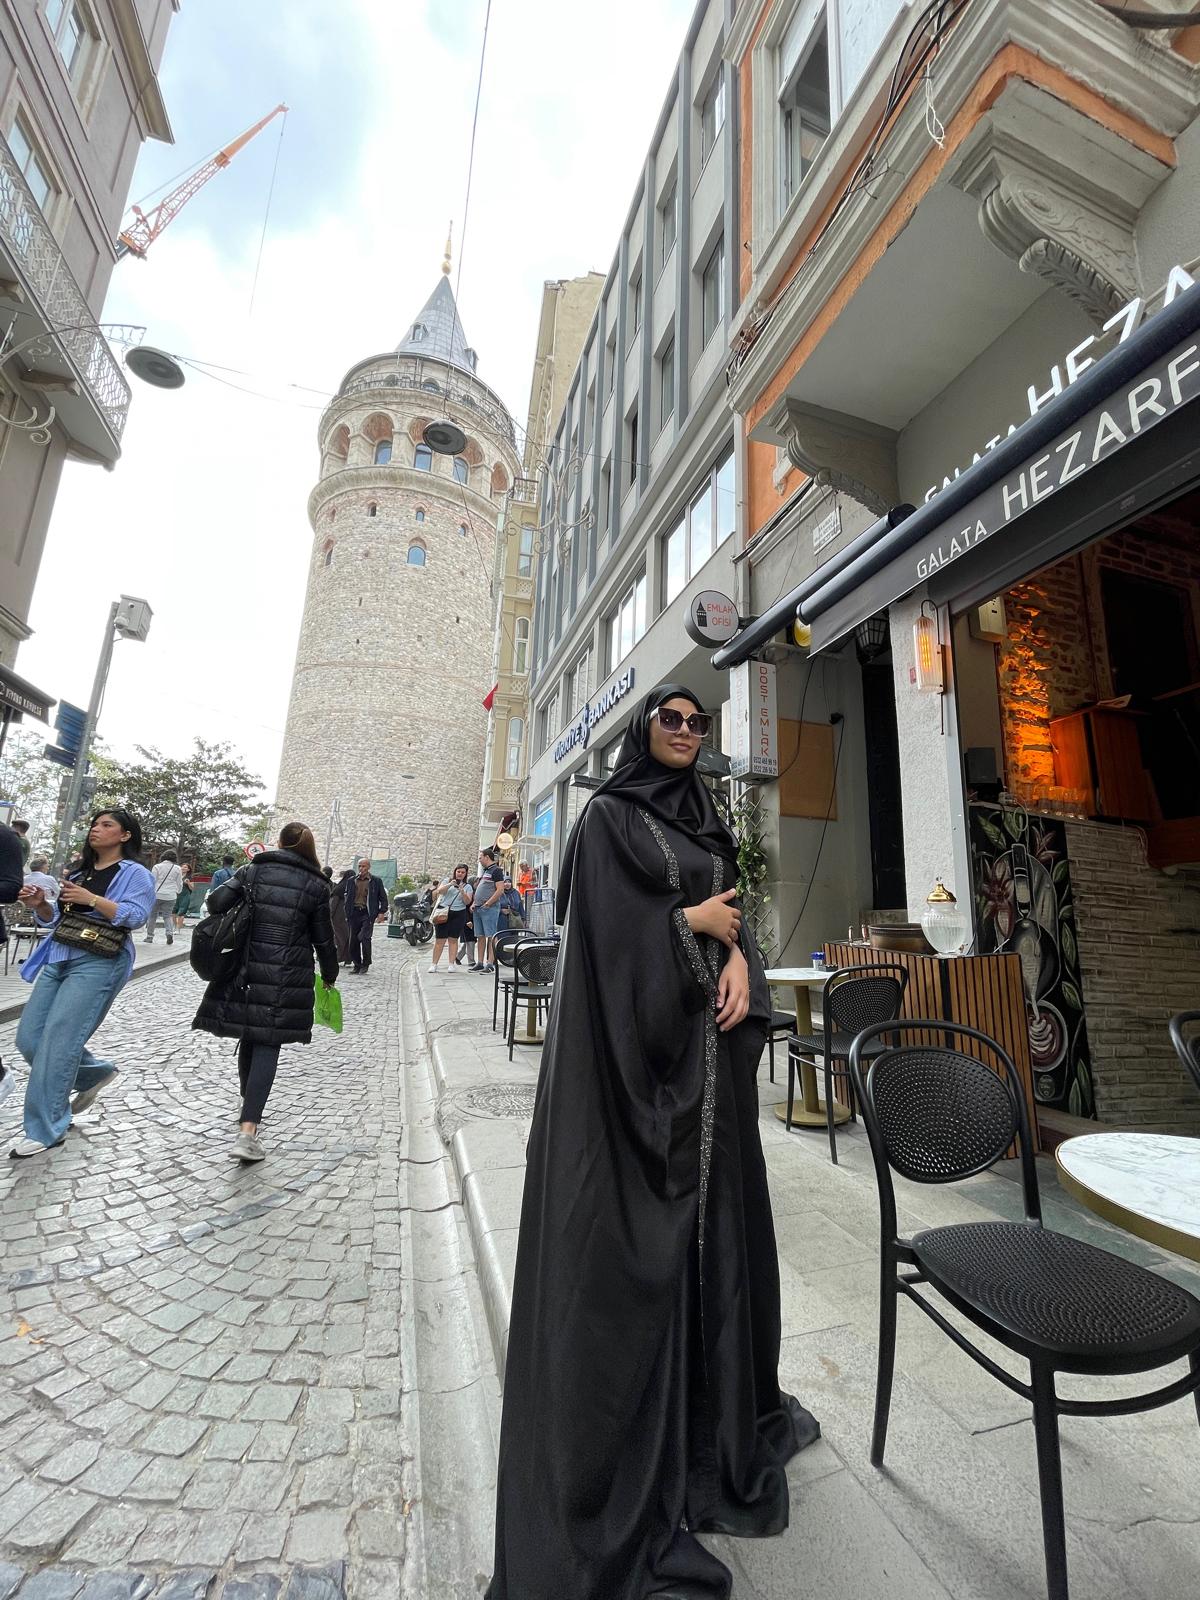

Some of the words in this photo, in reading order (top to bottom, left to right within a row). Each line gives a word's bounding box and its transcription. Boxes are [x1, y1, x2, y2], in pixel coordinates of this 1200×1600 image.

[916, 519, 988, 579] GALATA
[1002, 345, 1200, 521] HEZARF
[706, 603, 733, 614] EMLAK
[588, 667, 635, 729] BANKASI
[759, 665, 768, 703] DOST
[760, 708, 770, 757] EMLAK
